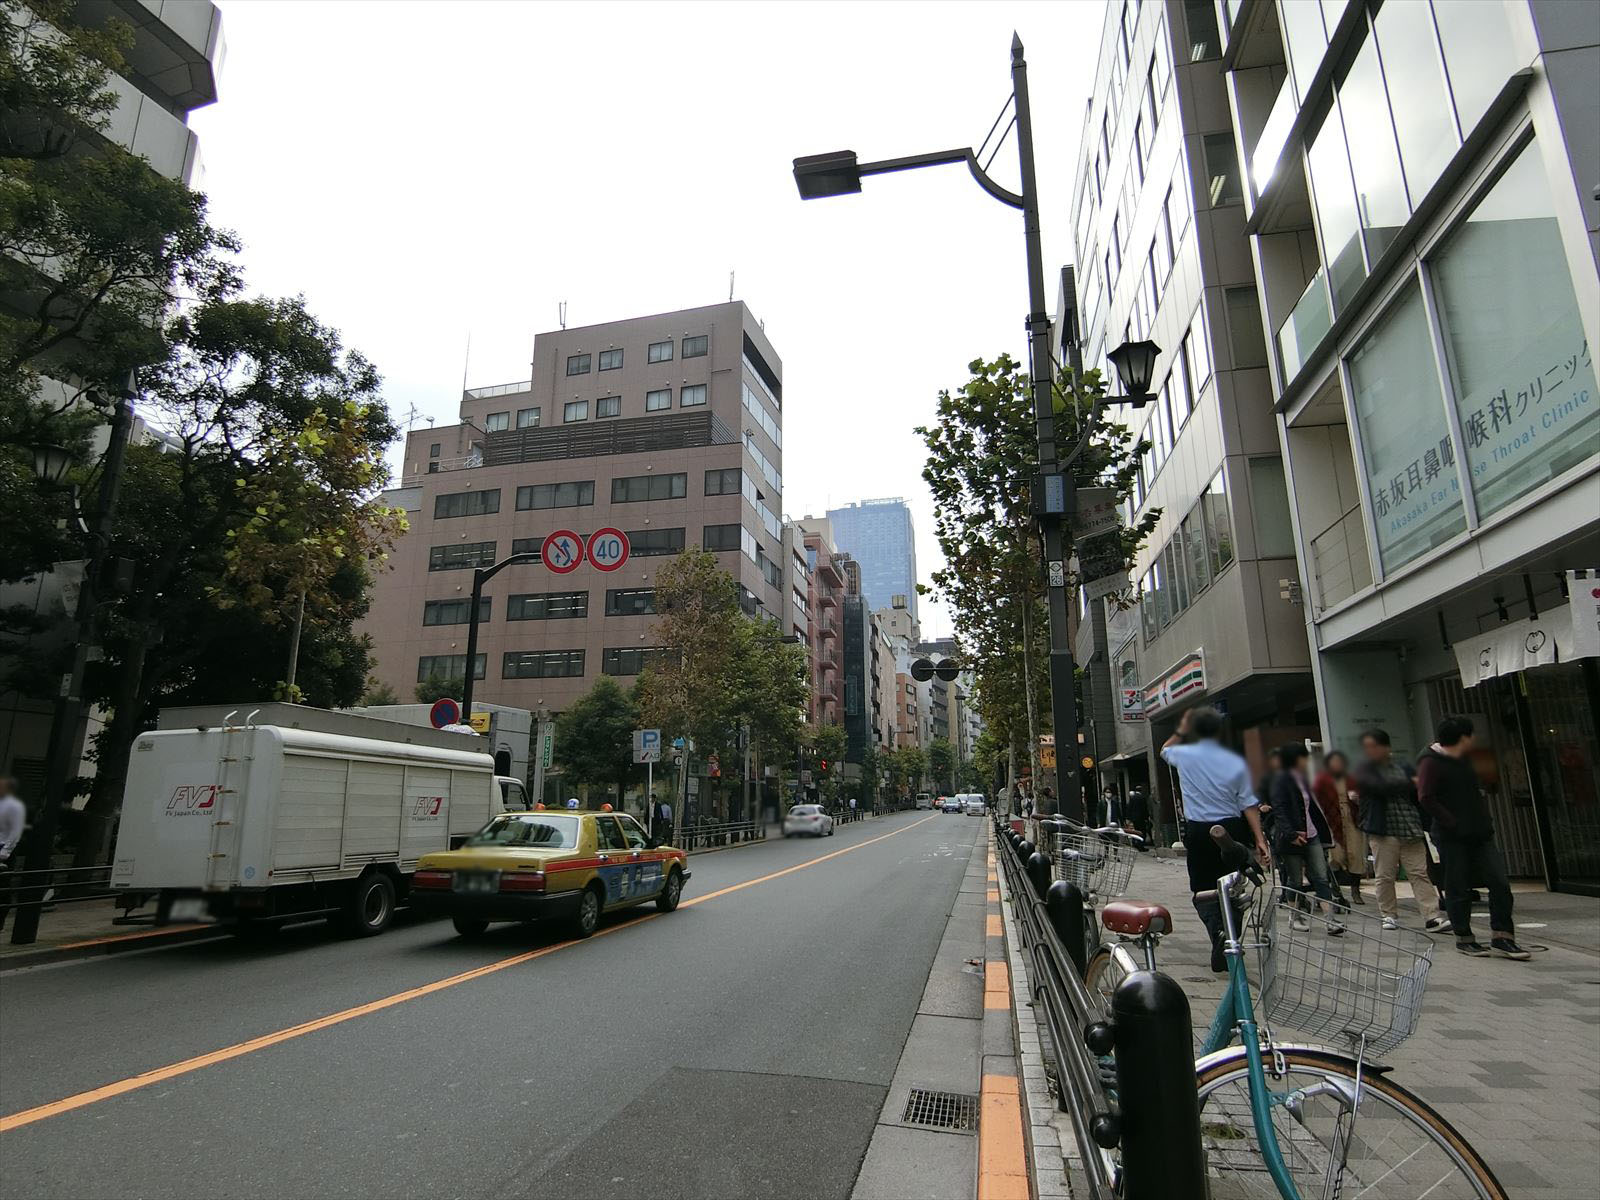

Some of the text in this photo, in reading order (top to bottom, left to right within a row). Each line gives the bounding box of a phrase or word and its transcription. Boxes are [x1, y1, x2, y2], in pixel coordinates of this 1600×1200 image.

[1390, 388, 1590, 533] Akasaka Ear Nse Throat Clinic
[596, 539, 620, 560] 40
[1051, 575, 1062, 587] 26
[642, 731, 658, 748] P
[649, 752, 660, 760] 入口
